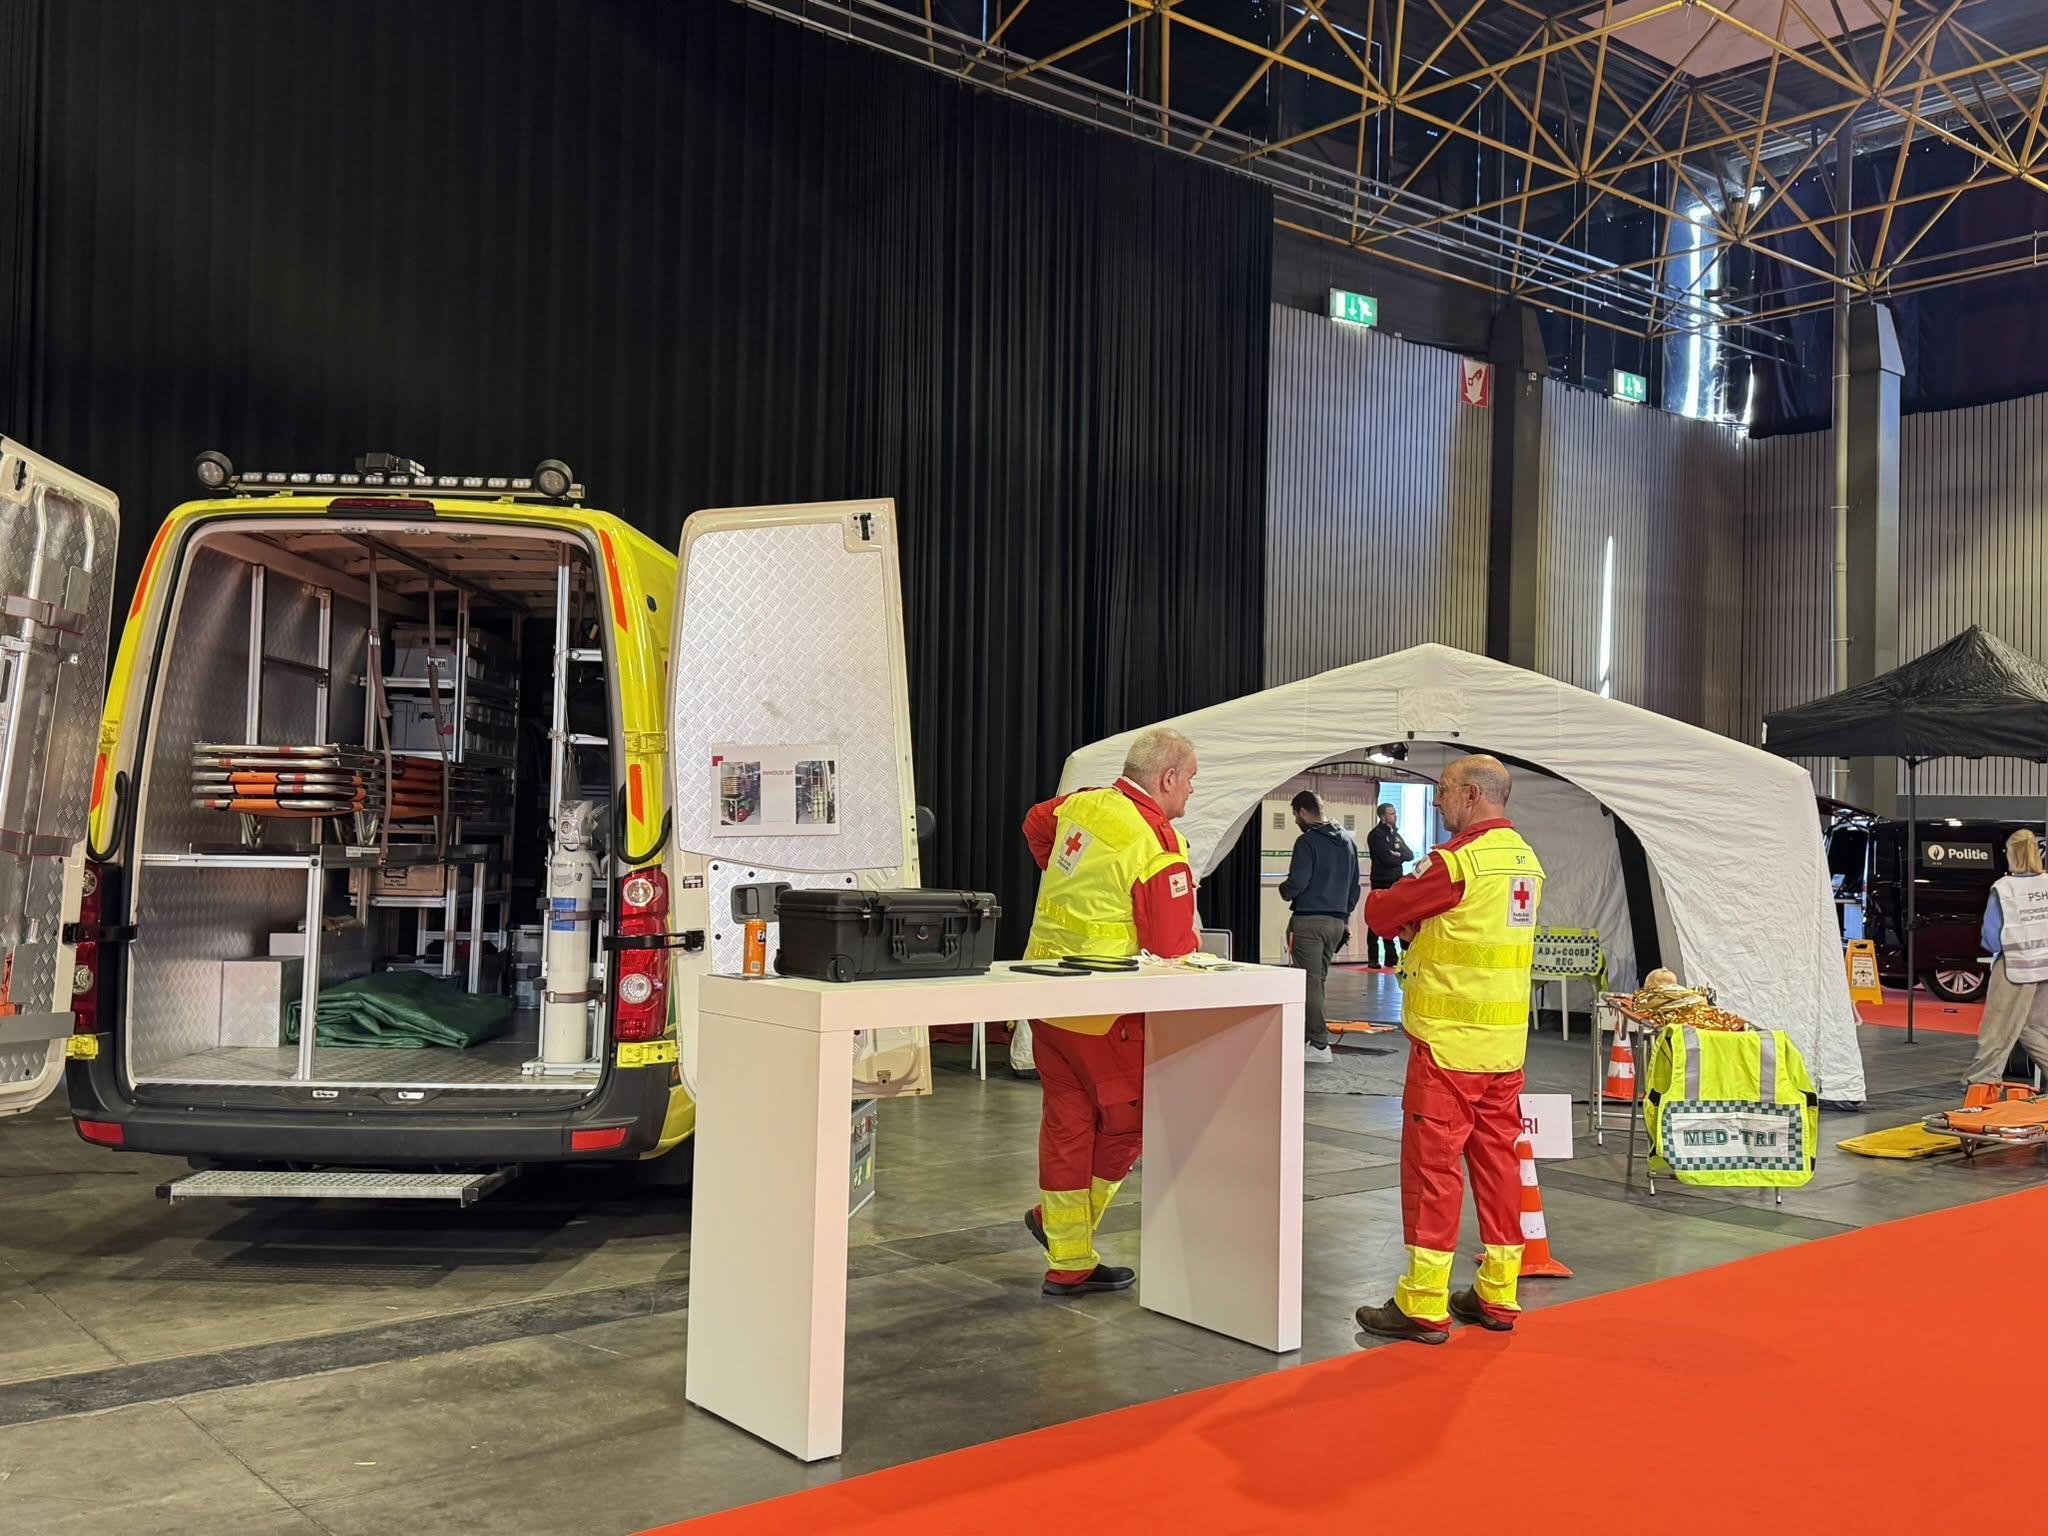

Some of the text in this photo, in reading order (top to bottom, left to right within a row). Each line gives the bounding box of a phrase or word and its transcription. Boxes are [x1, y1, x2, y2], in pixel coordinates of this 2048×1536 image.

[1948, 848, 1989, 860] Politie
[1522, 1117, 1539, 1135] RI
[1683, 1128, 1777, 1147] MED-TRI
